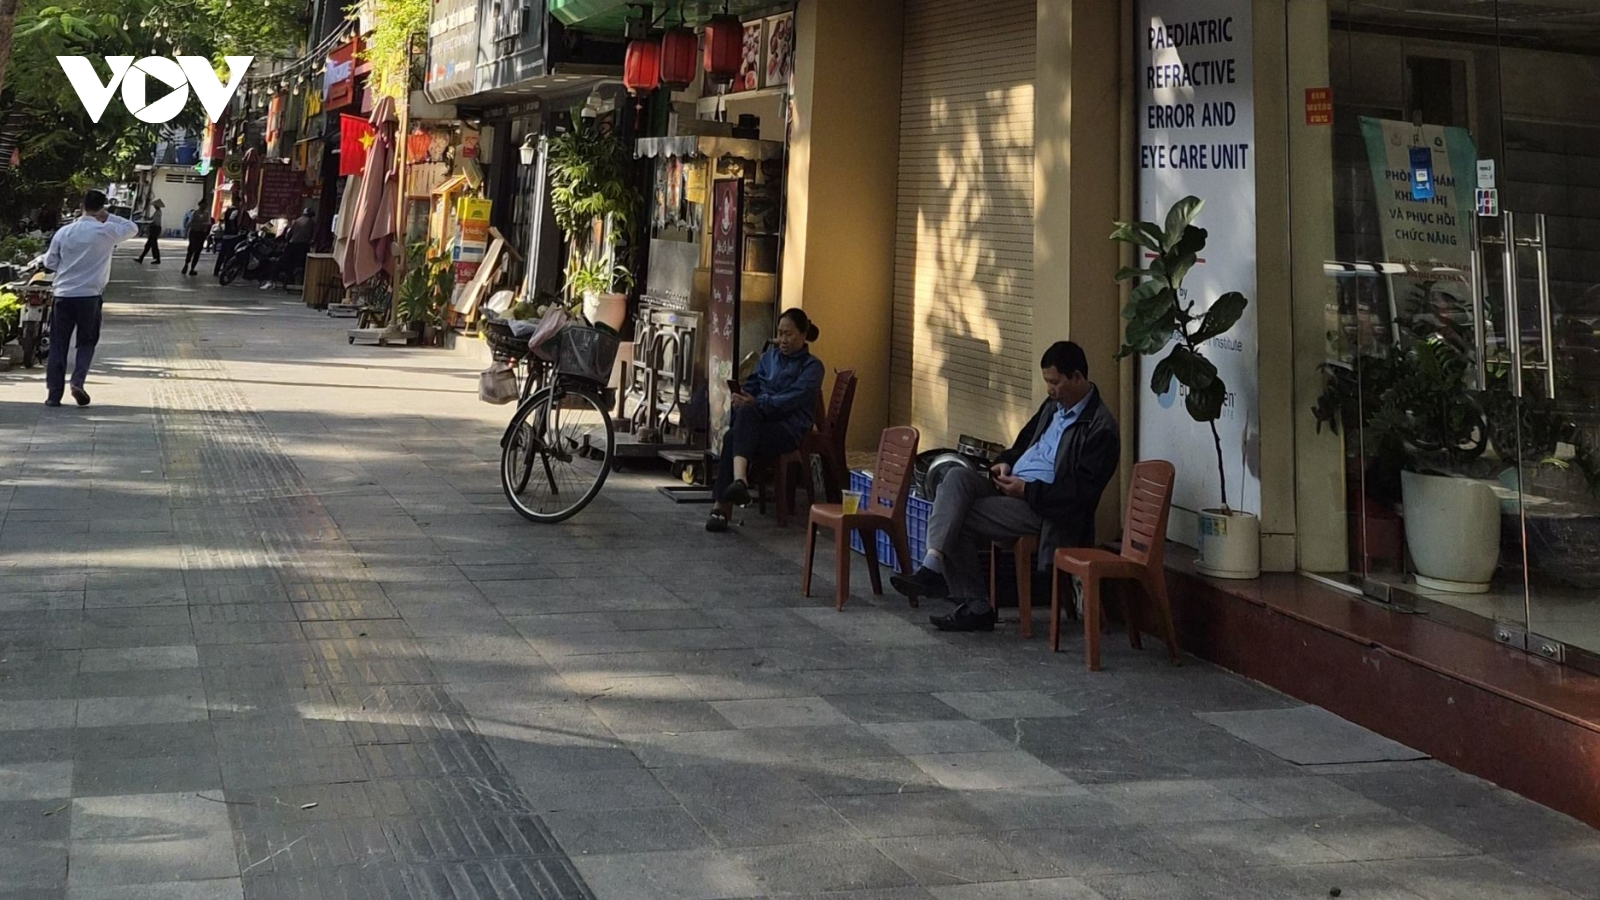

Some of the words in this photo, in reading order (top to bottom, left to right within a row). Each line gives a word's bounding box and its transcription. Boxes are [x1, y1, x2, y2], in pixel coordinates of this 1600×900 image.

[1148, 17, 1233, 50] PAEDIATRIC
[1147, 58, 1235, 89] REFRACTIVE
[1148, 103, 1195, 129] ERROR
[1201, 101, 1236, 127] AND
[1141, 144, 1165, 169] EYE
[1169, 144, 1207, 169] CARE
[1211, 143, 1249, 170] UNIT
[1432, 174, 1456, 187] HÁM
[1389, 207, 1404, 220] VÀ
[1406, 211, 1434, 225] PHỤC
[1436, 212, 1456, 226] HỒI
[1395, 228, 1425, 242] CHỨC
[1427, 231, 1457, 246] NĂNG
[1180, 287, 1188, 299] by
